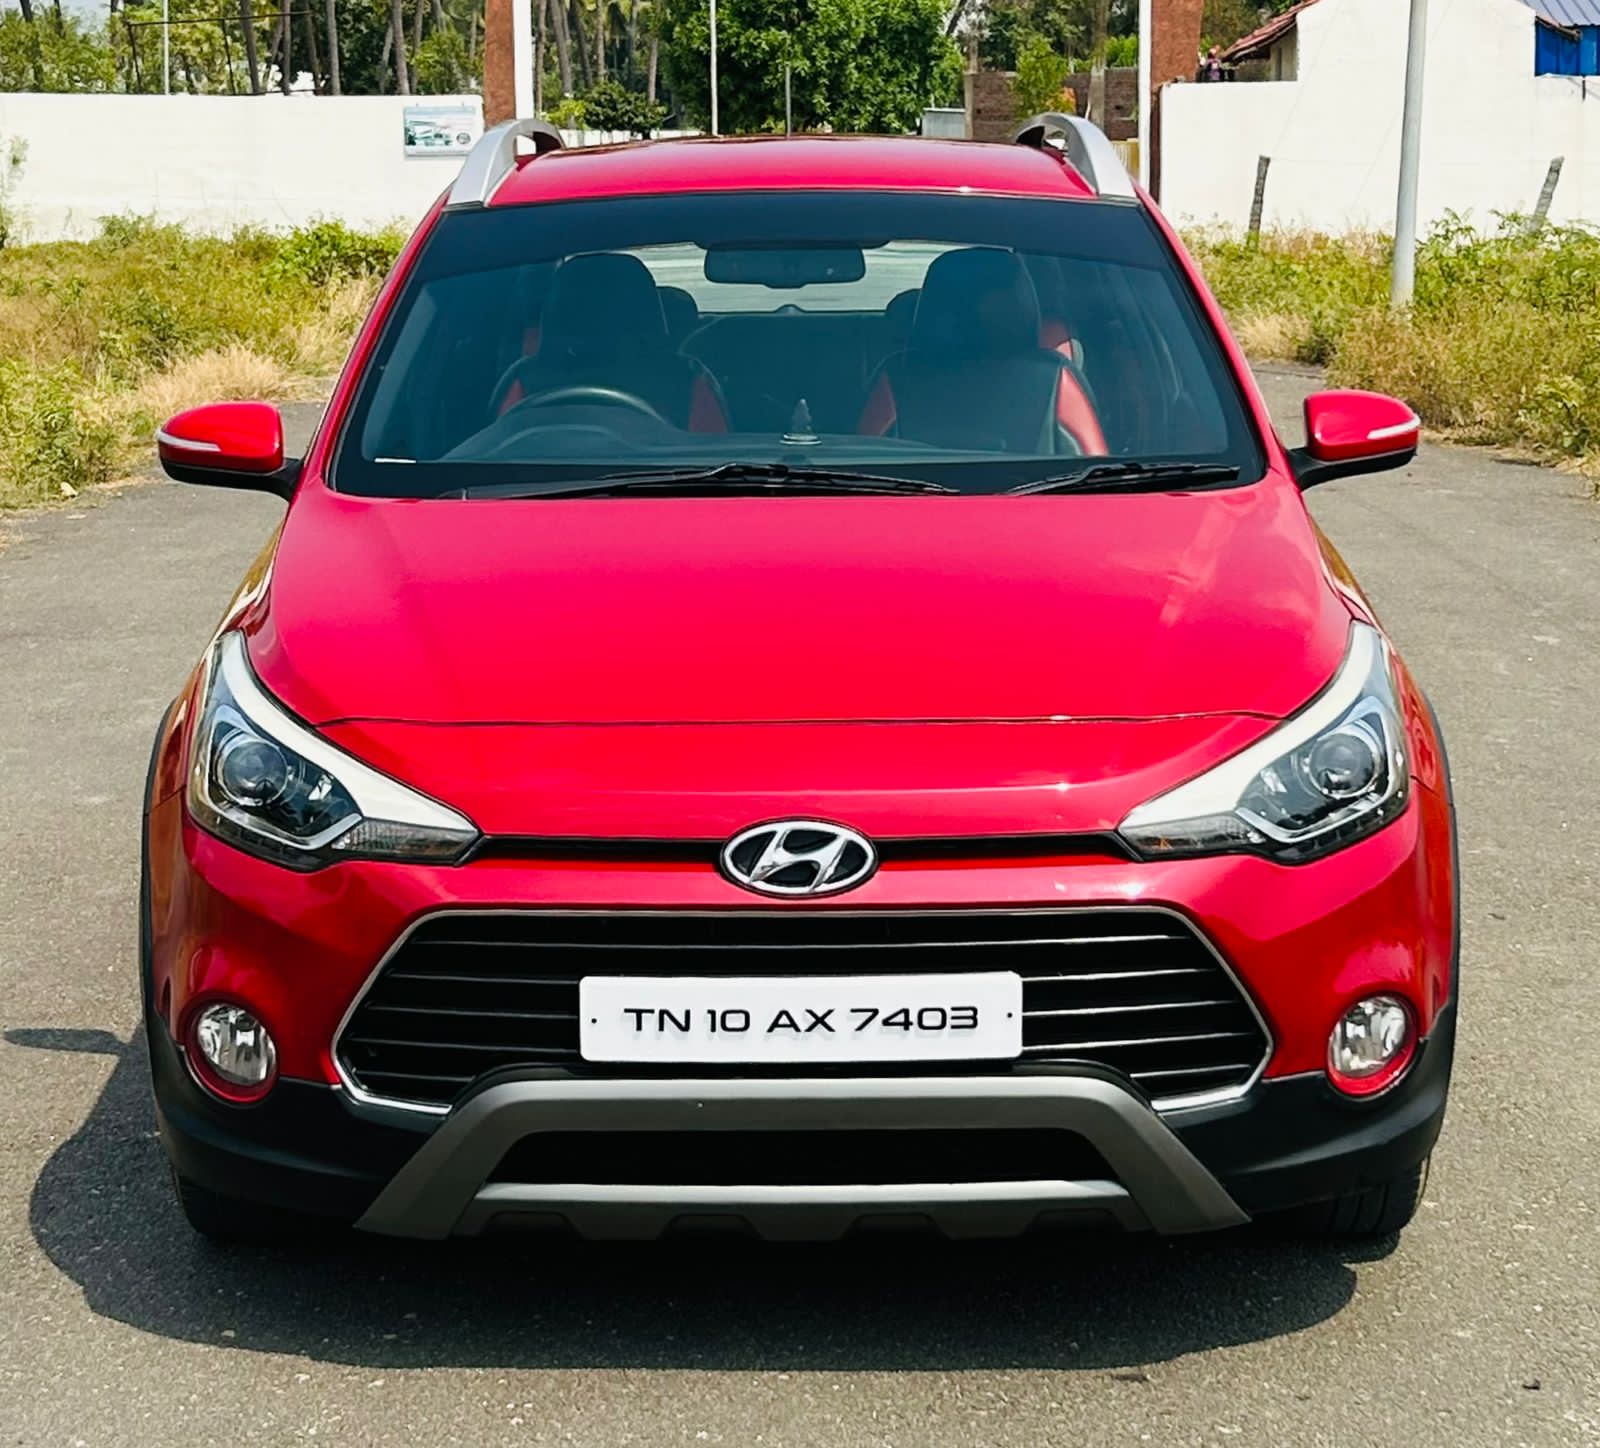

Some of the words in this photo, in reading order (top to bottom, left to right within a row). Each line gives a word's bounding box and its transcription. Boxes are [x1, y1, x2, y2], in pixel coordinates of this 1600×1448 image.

[623, 1008, 691, 1033] TN
[706, 1009, 751, 1033] 10
[766, 1008, 836, 1033] AX
[850, 1006, 979, 1032] 7403
